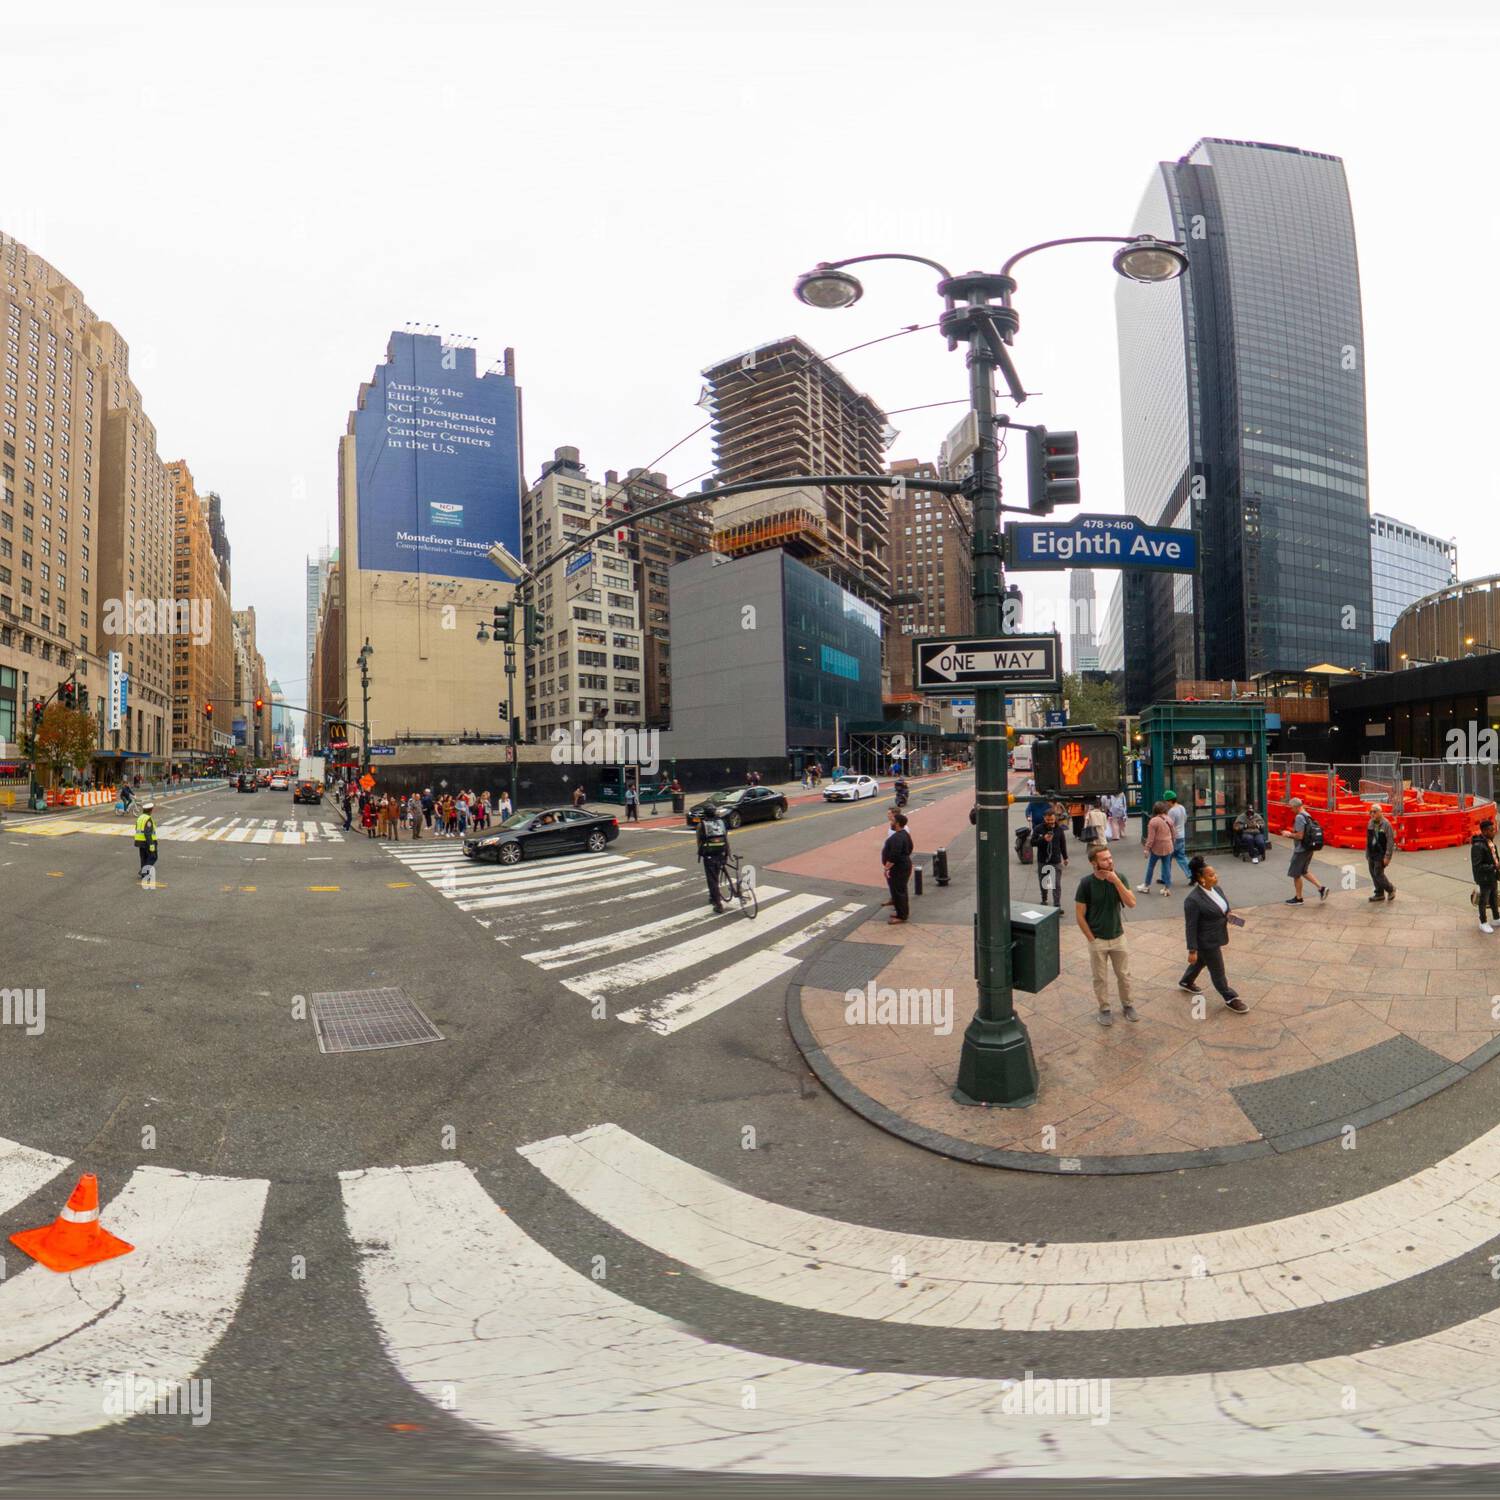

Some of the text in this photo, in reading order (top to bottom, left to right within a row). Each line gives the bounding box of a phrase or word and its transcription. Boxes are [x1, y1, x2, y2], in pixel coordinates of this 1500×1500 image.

[387, 381, 464, 398] Among the
[387, 391, 443, 405] Elite 1%
[387, 403, 497, 425] NCI-Designated
[387, 414, 495, 436] Comprehensive
[387, 426, 491, 447] Cancer Centers
[388, 438, 459, 455] in the U.S.
[1083, 519, 1134, 530] 478 460
[396, 531, 454, 546] Montefiore
[1032, 531, 1182, 559] Eighth Ave
[395, 541, 488, 559] Comprehensive Cancer Cen
[940, 652, 1034, 671] ONE WAY
